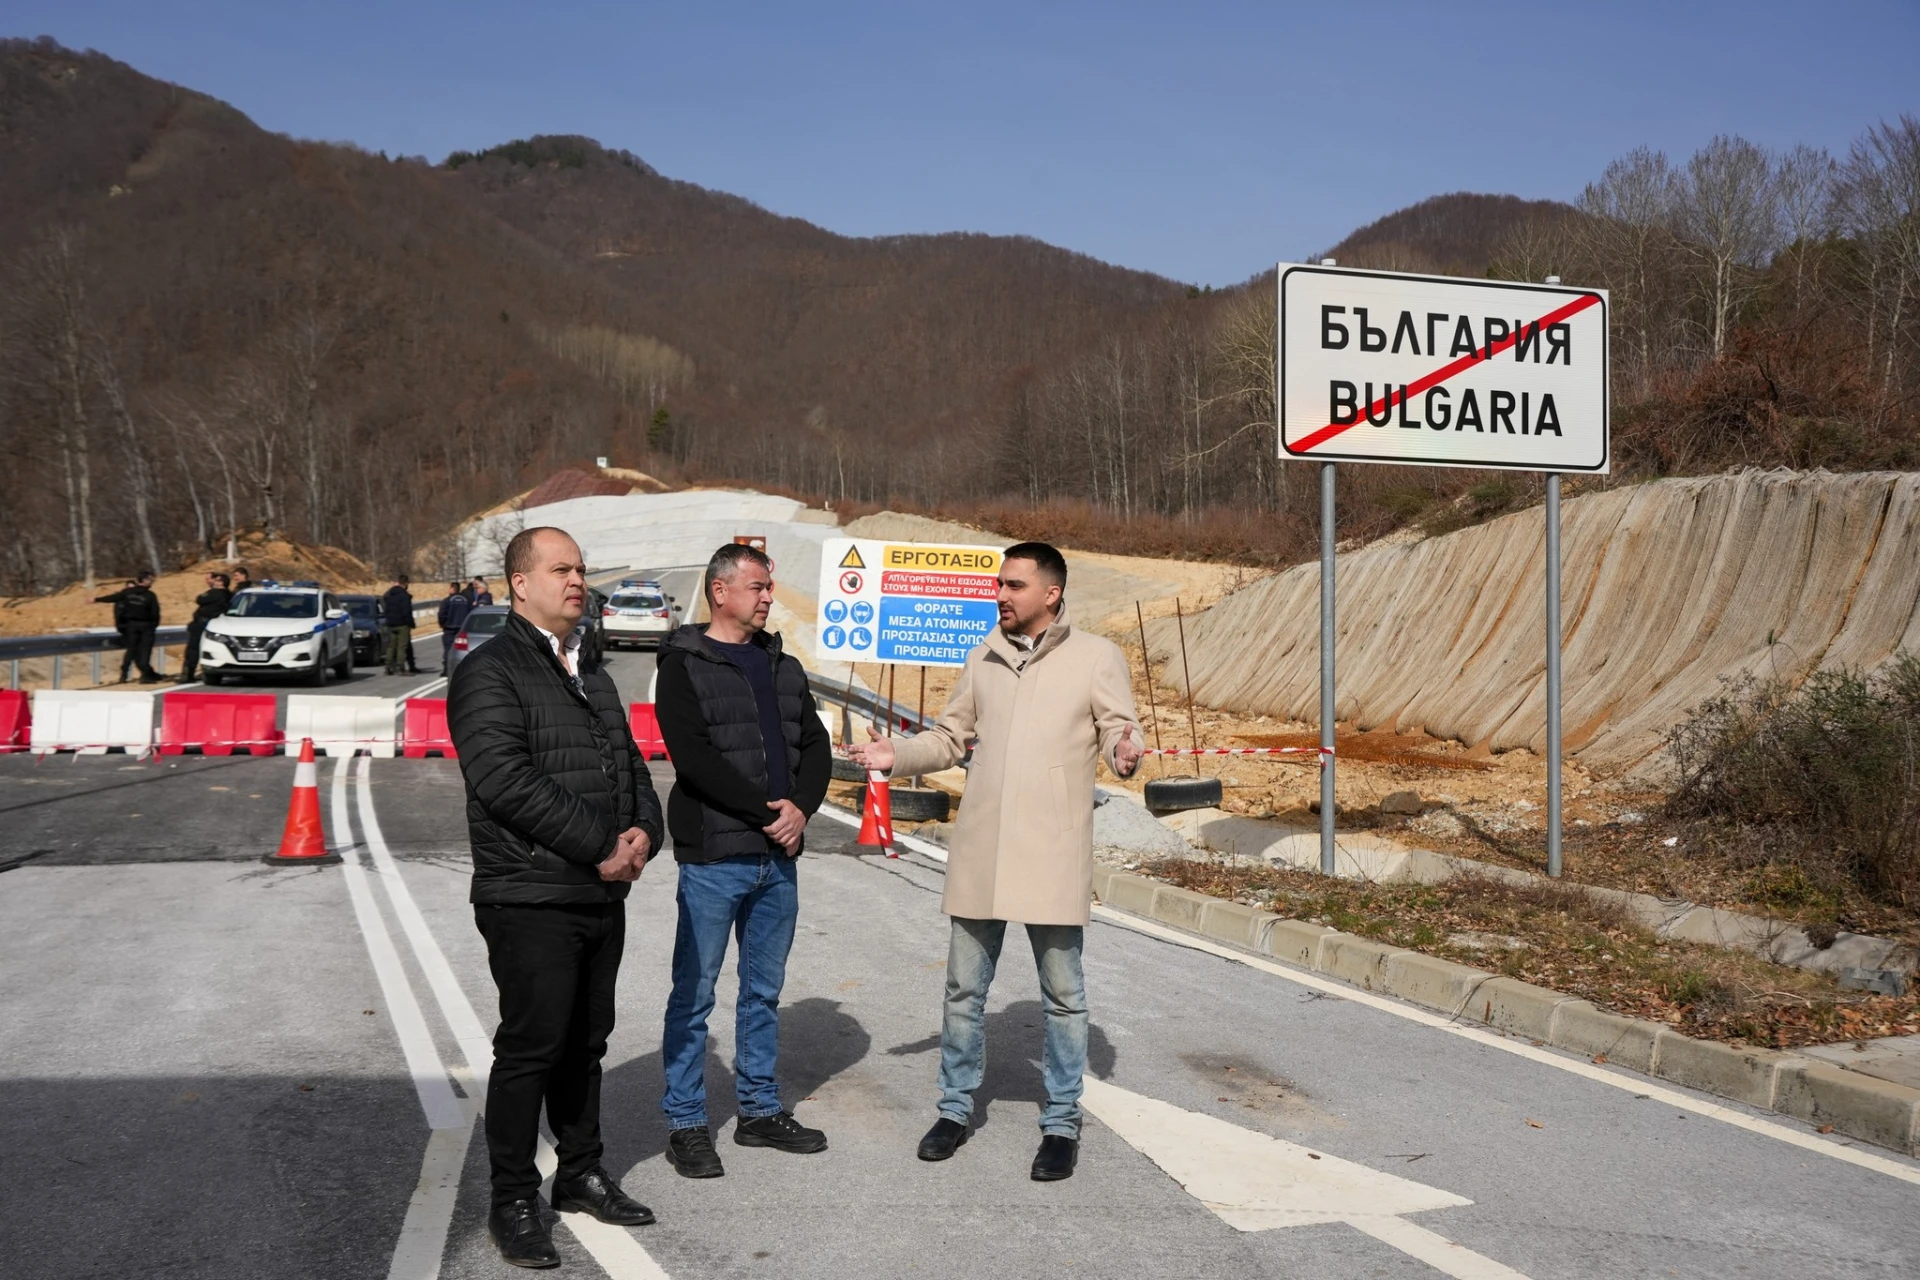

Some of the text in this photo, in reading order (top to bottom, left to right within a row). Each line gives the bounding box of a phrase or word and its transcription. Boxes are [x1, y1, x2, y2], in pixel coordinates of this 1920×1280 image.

[1321, 304, 1571, 366] БЪЛГАРИЯ
[1330, 379, 1563, 437] BULGARIA
[891, 550, 994, 569] ΕΡΓΟΤΑΞΙΟ
[883, 583, 909, 592] ΣΤΟΥΣ
[925, 586, 962, 595] ΕΧΟΝΤΕΣ
[963, 588, 997, 597] ΕΡΓΑΣΙΑ
[958, 578, 993, 587] ΕΙΣΟΔΟΣ
[914, 602, 964, 616] ΦΟΡΑΤΕ
[888, 615, 988, 632] ΜΕΣΑ ΑΤΟΜΙΚΗΣ
[881, 629, 986, 646] ΠΡΟΣΤΑΣΙΑΣ ΟΠΩ
[894, 644, 970, 660] ΠΡΟΒΛΕΠΕΤ
